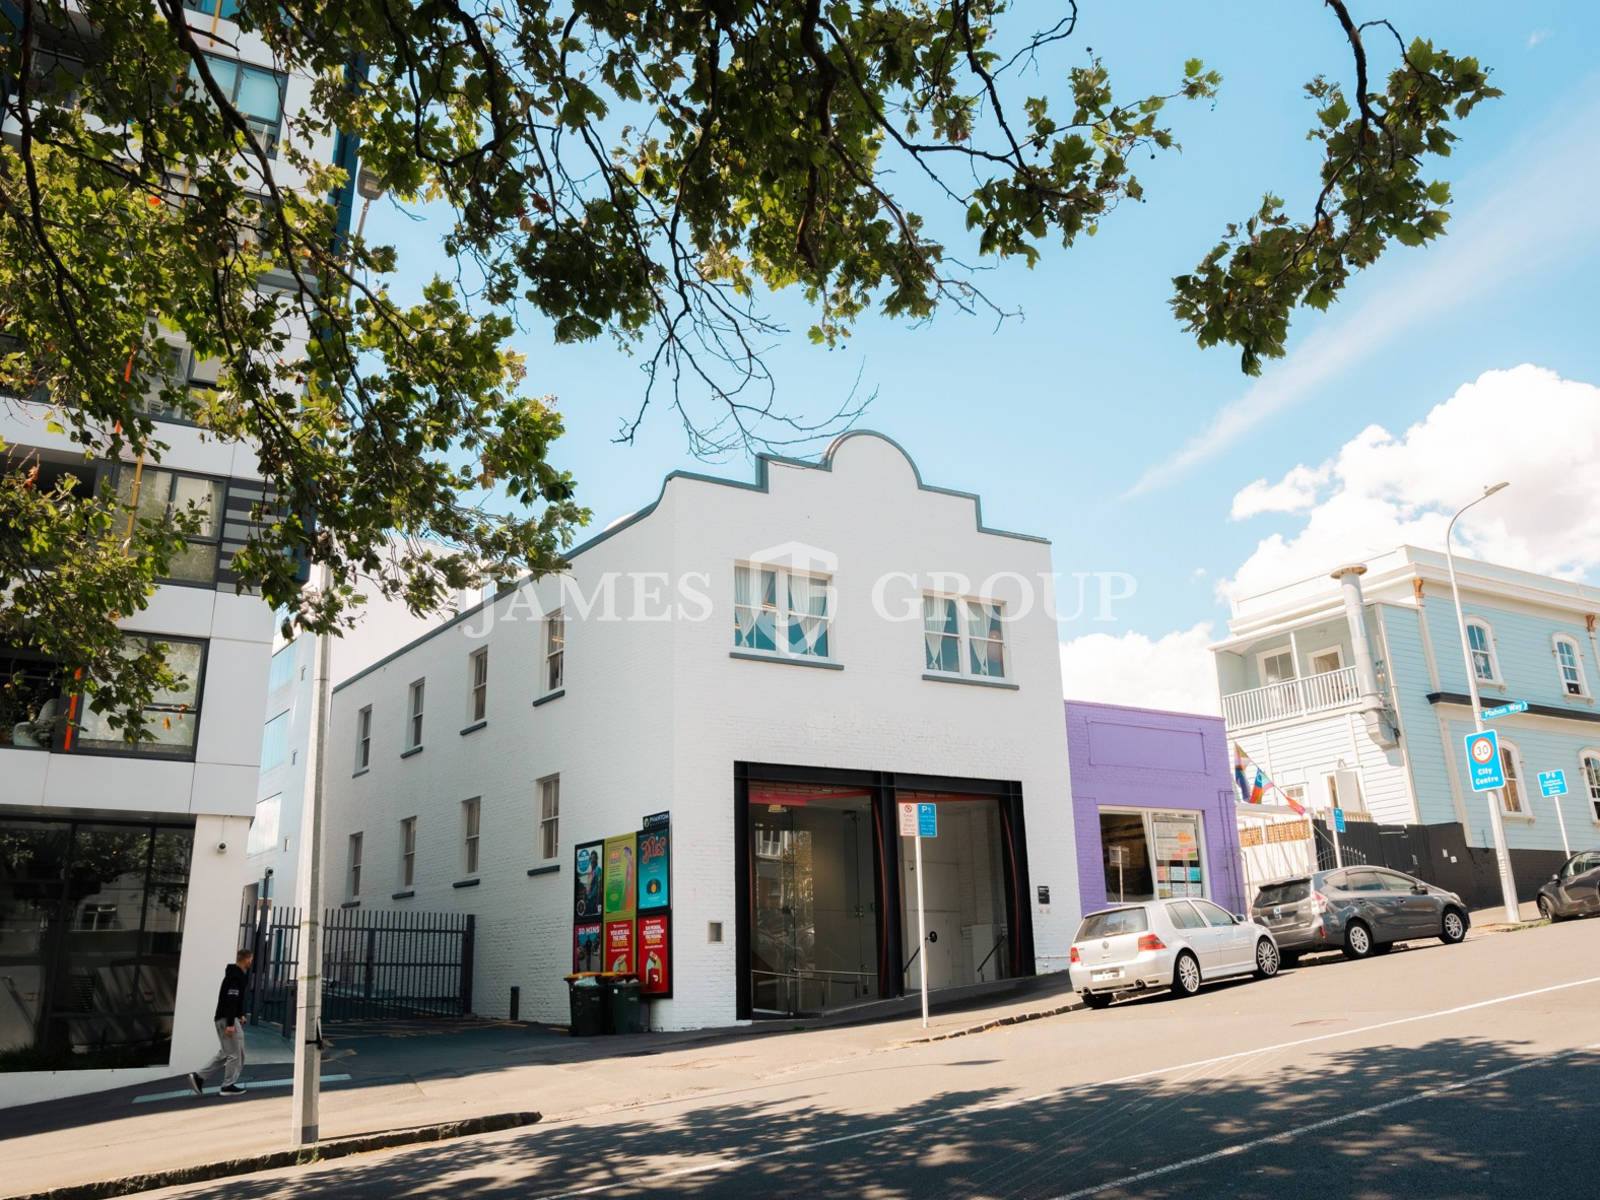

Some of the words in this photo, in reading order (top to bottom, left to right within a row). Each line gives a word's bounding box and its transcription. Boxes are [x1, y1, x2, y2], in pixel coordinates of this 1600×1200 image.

[1508, 703, 1522, 712] Way
[1476, 744, 1489, 756] 30
[1478, 767, 1493, 775] City
[1475, 777, 1499, 785] Centre
